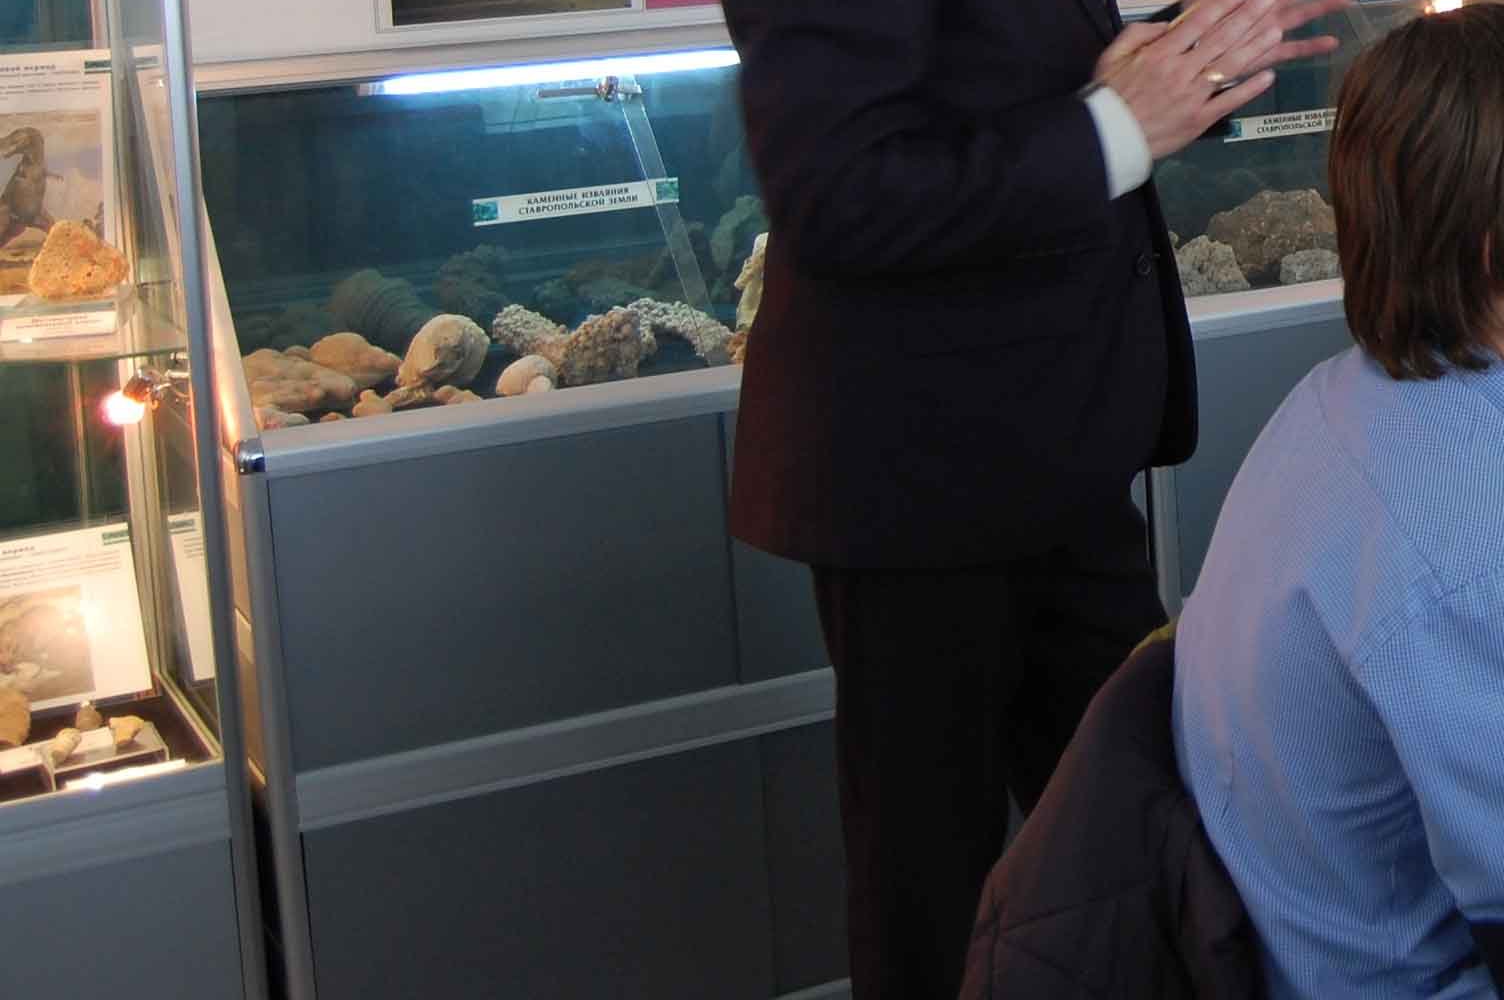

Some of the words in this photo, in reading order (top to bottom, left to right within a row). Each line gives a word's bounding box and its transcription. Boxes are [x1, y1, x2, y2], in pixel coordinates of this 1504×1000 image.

[517, 197, 606, 216] СТАВРОПОЛЬСКОЙ
[609, 193, 639, 206] ЗЕМЛИ
[527, 192, 578, 206] КАМЕННЫЕ
[581, 186, 630, 200] ИЗВАЯНИЯ
